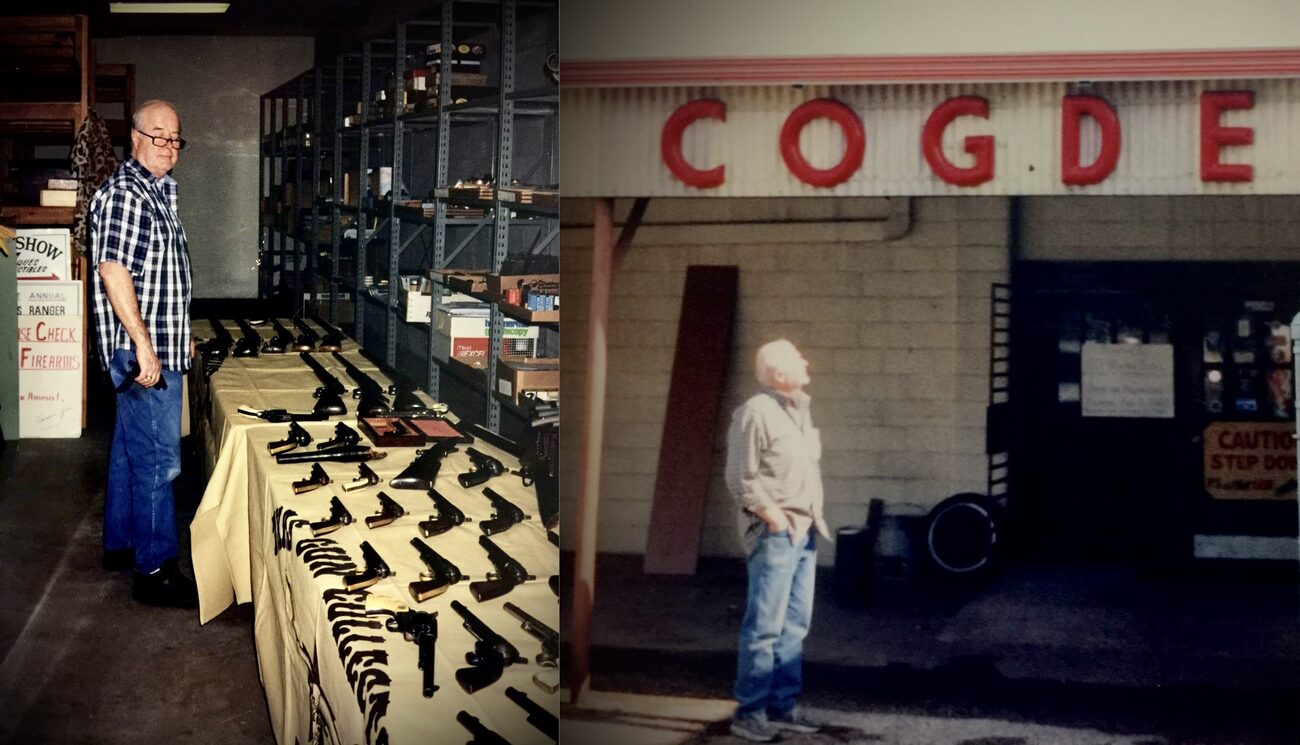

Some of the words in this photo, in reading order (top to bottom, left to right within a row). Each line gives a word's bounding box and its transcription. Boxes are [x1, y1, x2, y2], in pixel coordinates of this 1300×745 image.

[15, 236, 63, 261] SHOW
[28, 292, 67, 300] ANNUAL
[29, 305, 66, 316] RANGER
[35, 321, 77, 342] CHECK
[20, 347, 81, 369] FIREARMS
[1218, 430, 1296, 450] CAUTIO
[1210, 453, 1259, 470] STEP
